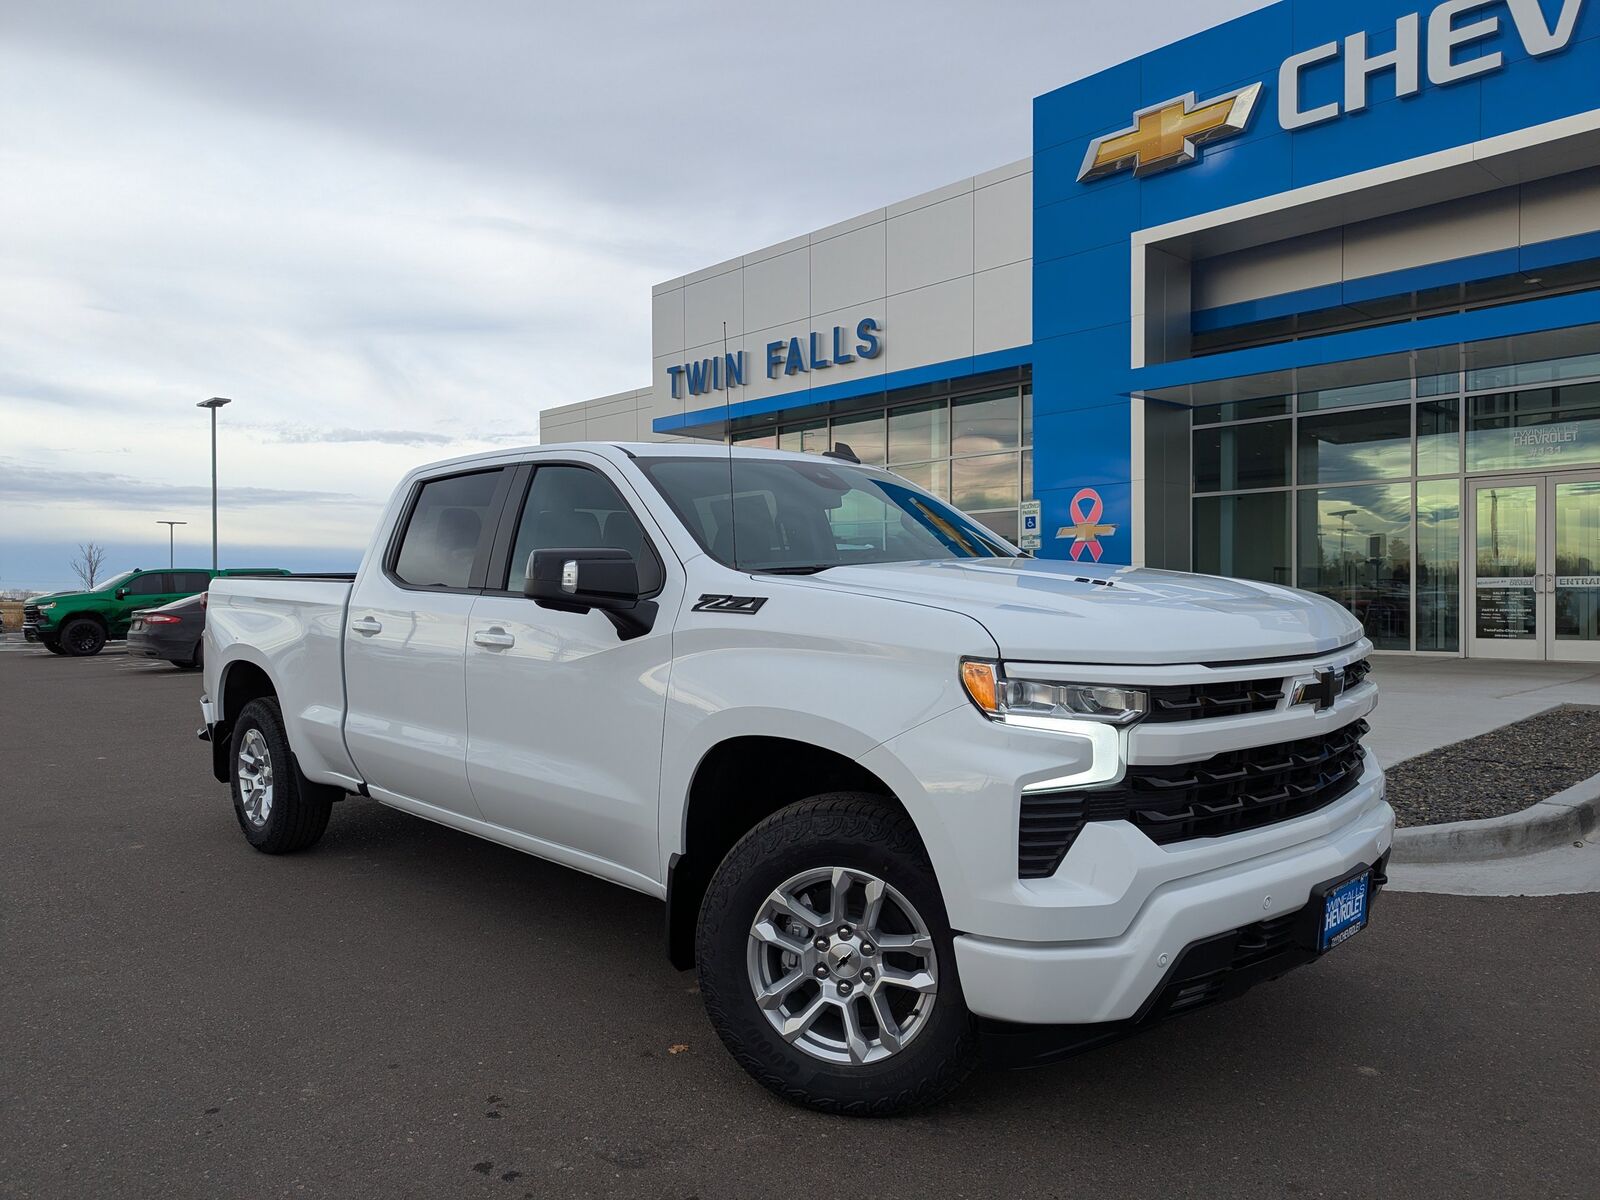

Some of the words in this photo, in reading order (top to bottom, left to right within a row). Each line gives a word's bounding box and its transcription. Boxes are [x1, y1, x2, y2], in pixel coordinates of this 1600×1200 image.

[1278, 0, 1582, 130] CHEV
[667, 351, 749, 399] TWIN
[767, 318, 881, 379] FALLS
[1513, 431, 1577, 447] CHEVROLET
[1324, 893, 1364, 931] HEVROLET
[1326, 883, 1365, 912] WINFALLS
